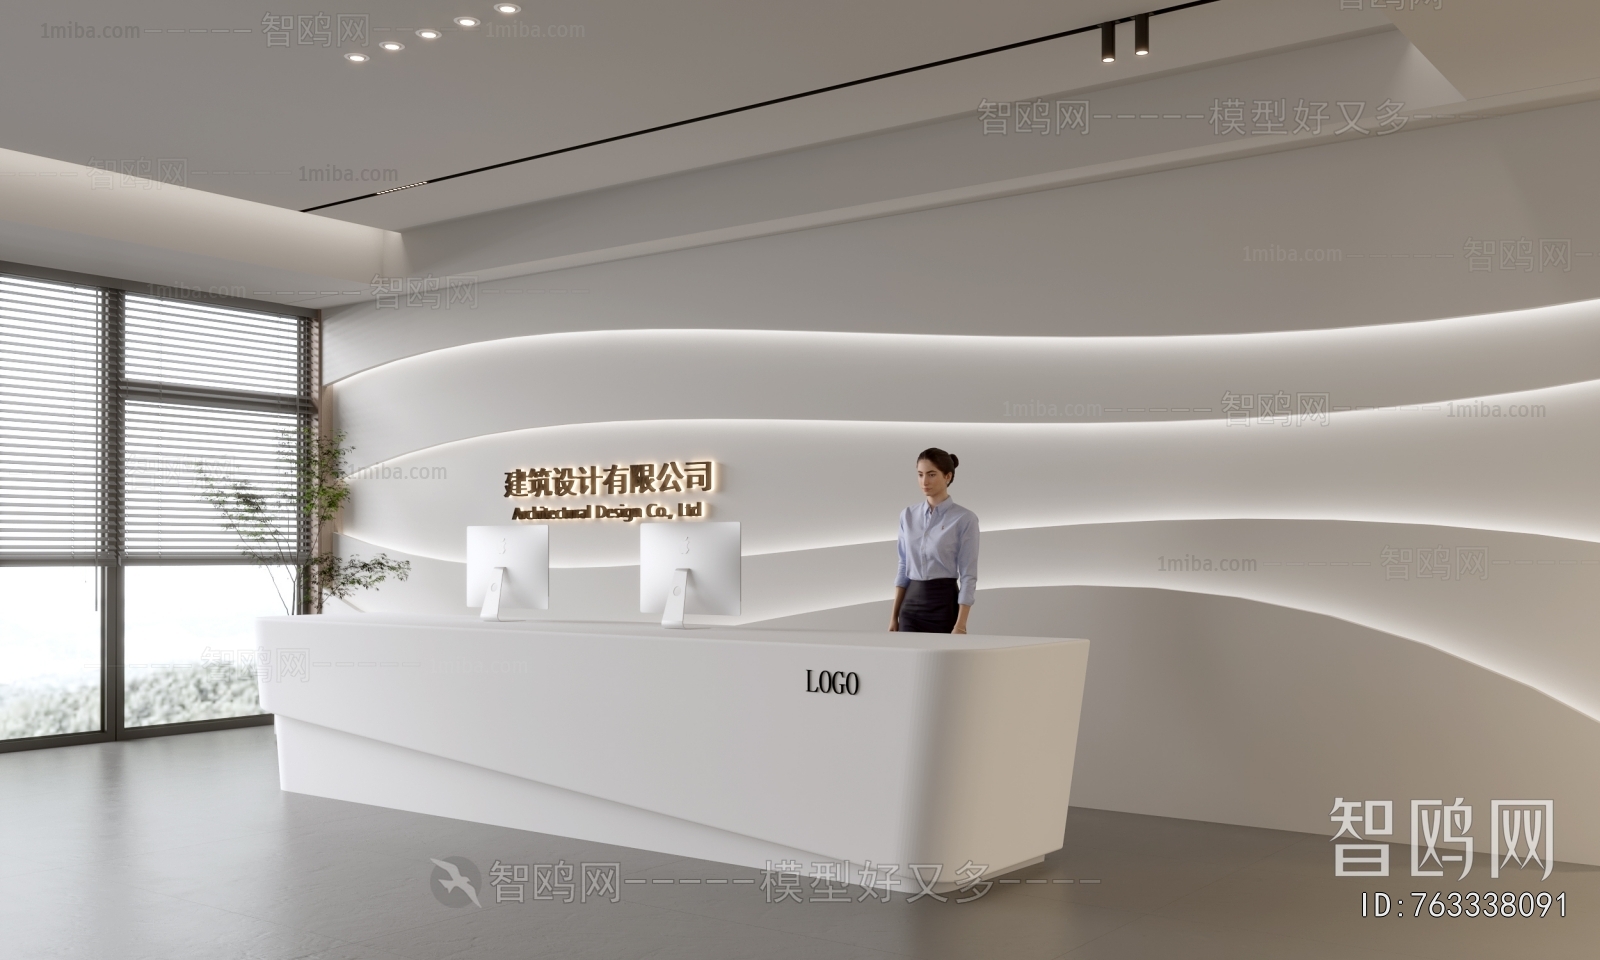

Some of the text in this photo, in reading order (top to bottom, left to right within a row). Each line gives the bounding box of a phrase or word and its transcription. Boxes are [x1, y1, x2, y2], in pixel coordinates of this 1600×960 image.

[503, 461, 714, 498] 建筑设计有限公司
[511, 504, 591, 521] Architectural
[595, 505, 643, 522] Design
[677, 501, 703, 517] Ltd
[805, 669, 860, 696] LOGO
